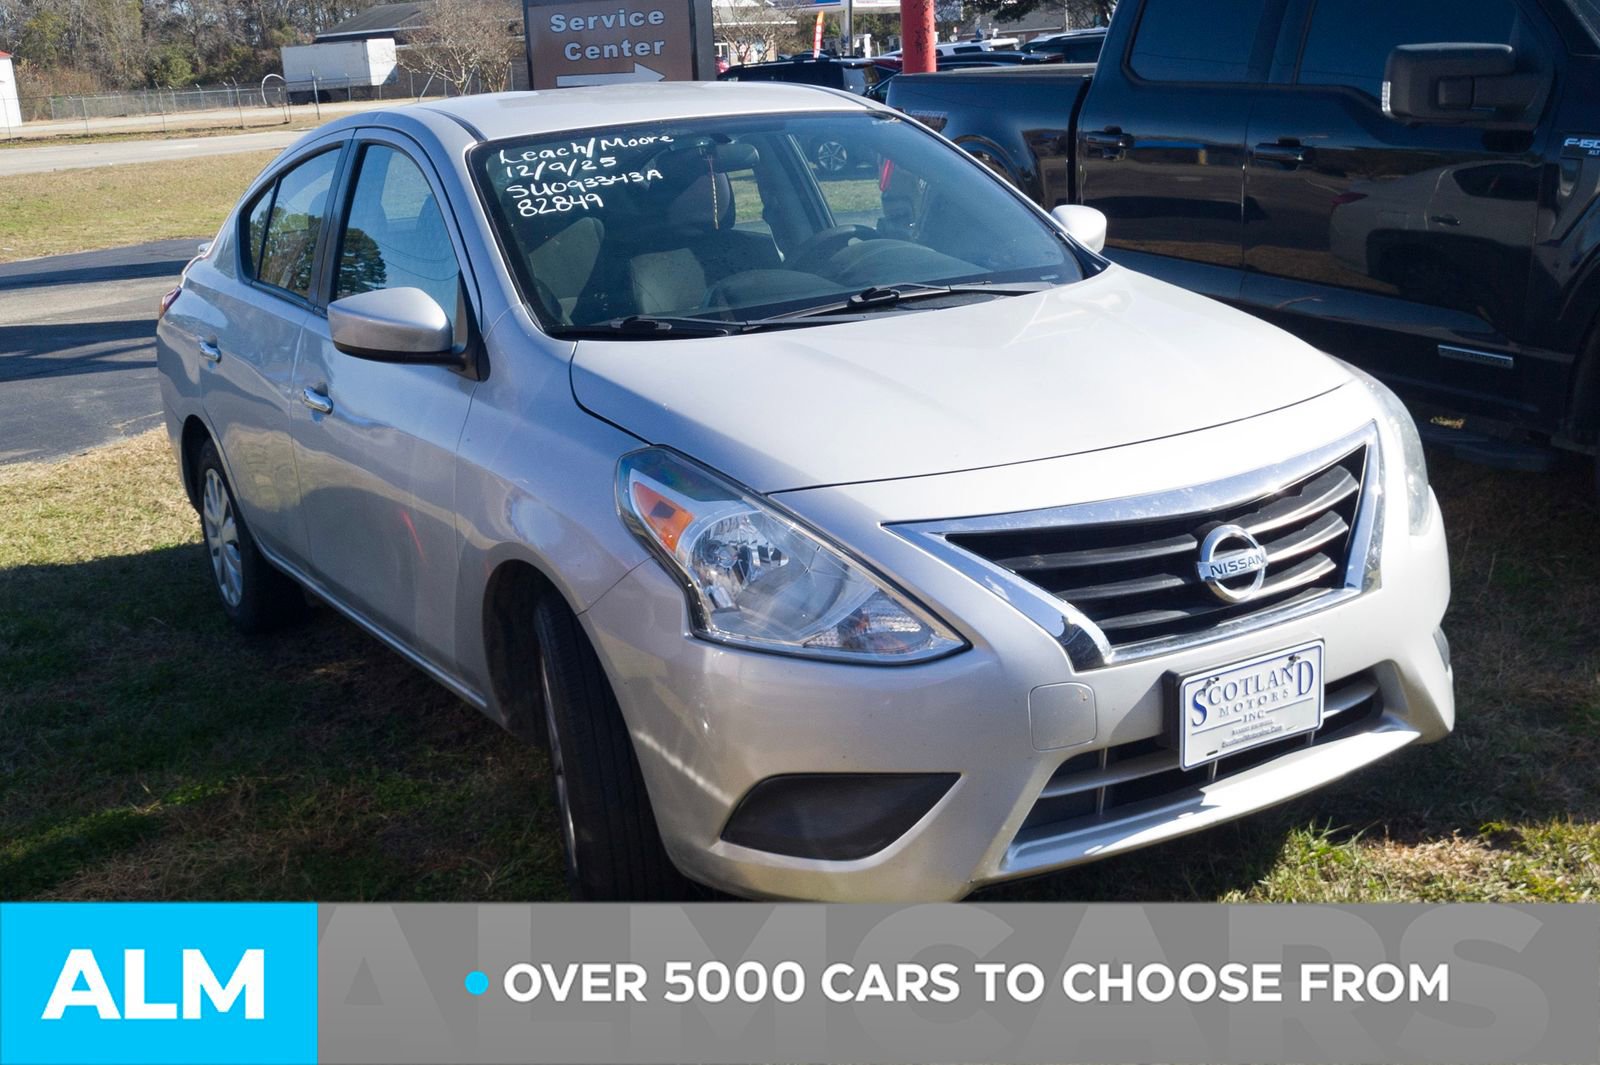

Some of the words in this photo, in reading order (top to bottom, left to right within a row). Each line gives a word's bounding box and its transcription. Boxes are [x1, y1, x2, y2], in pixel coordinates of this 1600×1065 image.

[550, 9, 665, 33] Service
[564, 39, 665, 61] Center
[506, 156, 617, 180] 12/9/25
[517, 193, 604, 217] 82849
[1210, 554, 1264, 577] NISSAN
[1191, 660, 1314, 727] SCOTLAND
[1218, 688, 1289, 718] MOTORS
[1241, 709, 1265, 723] INC
